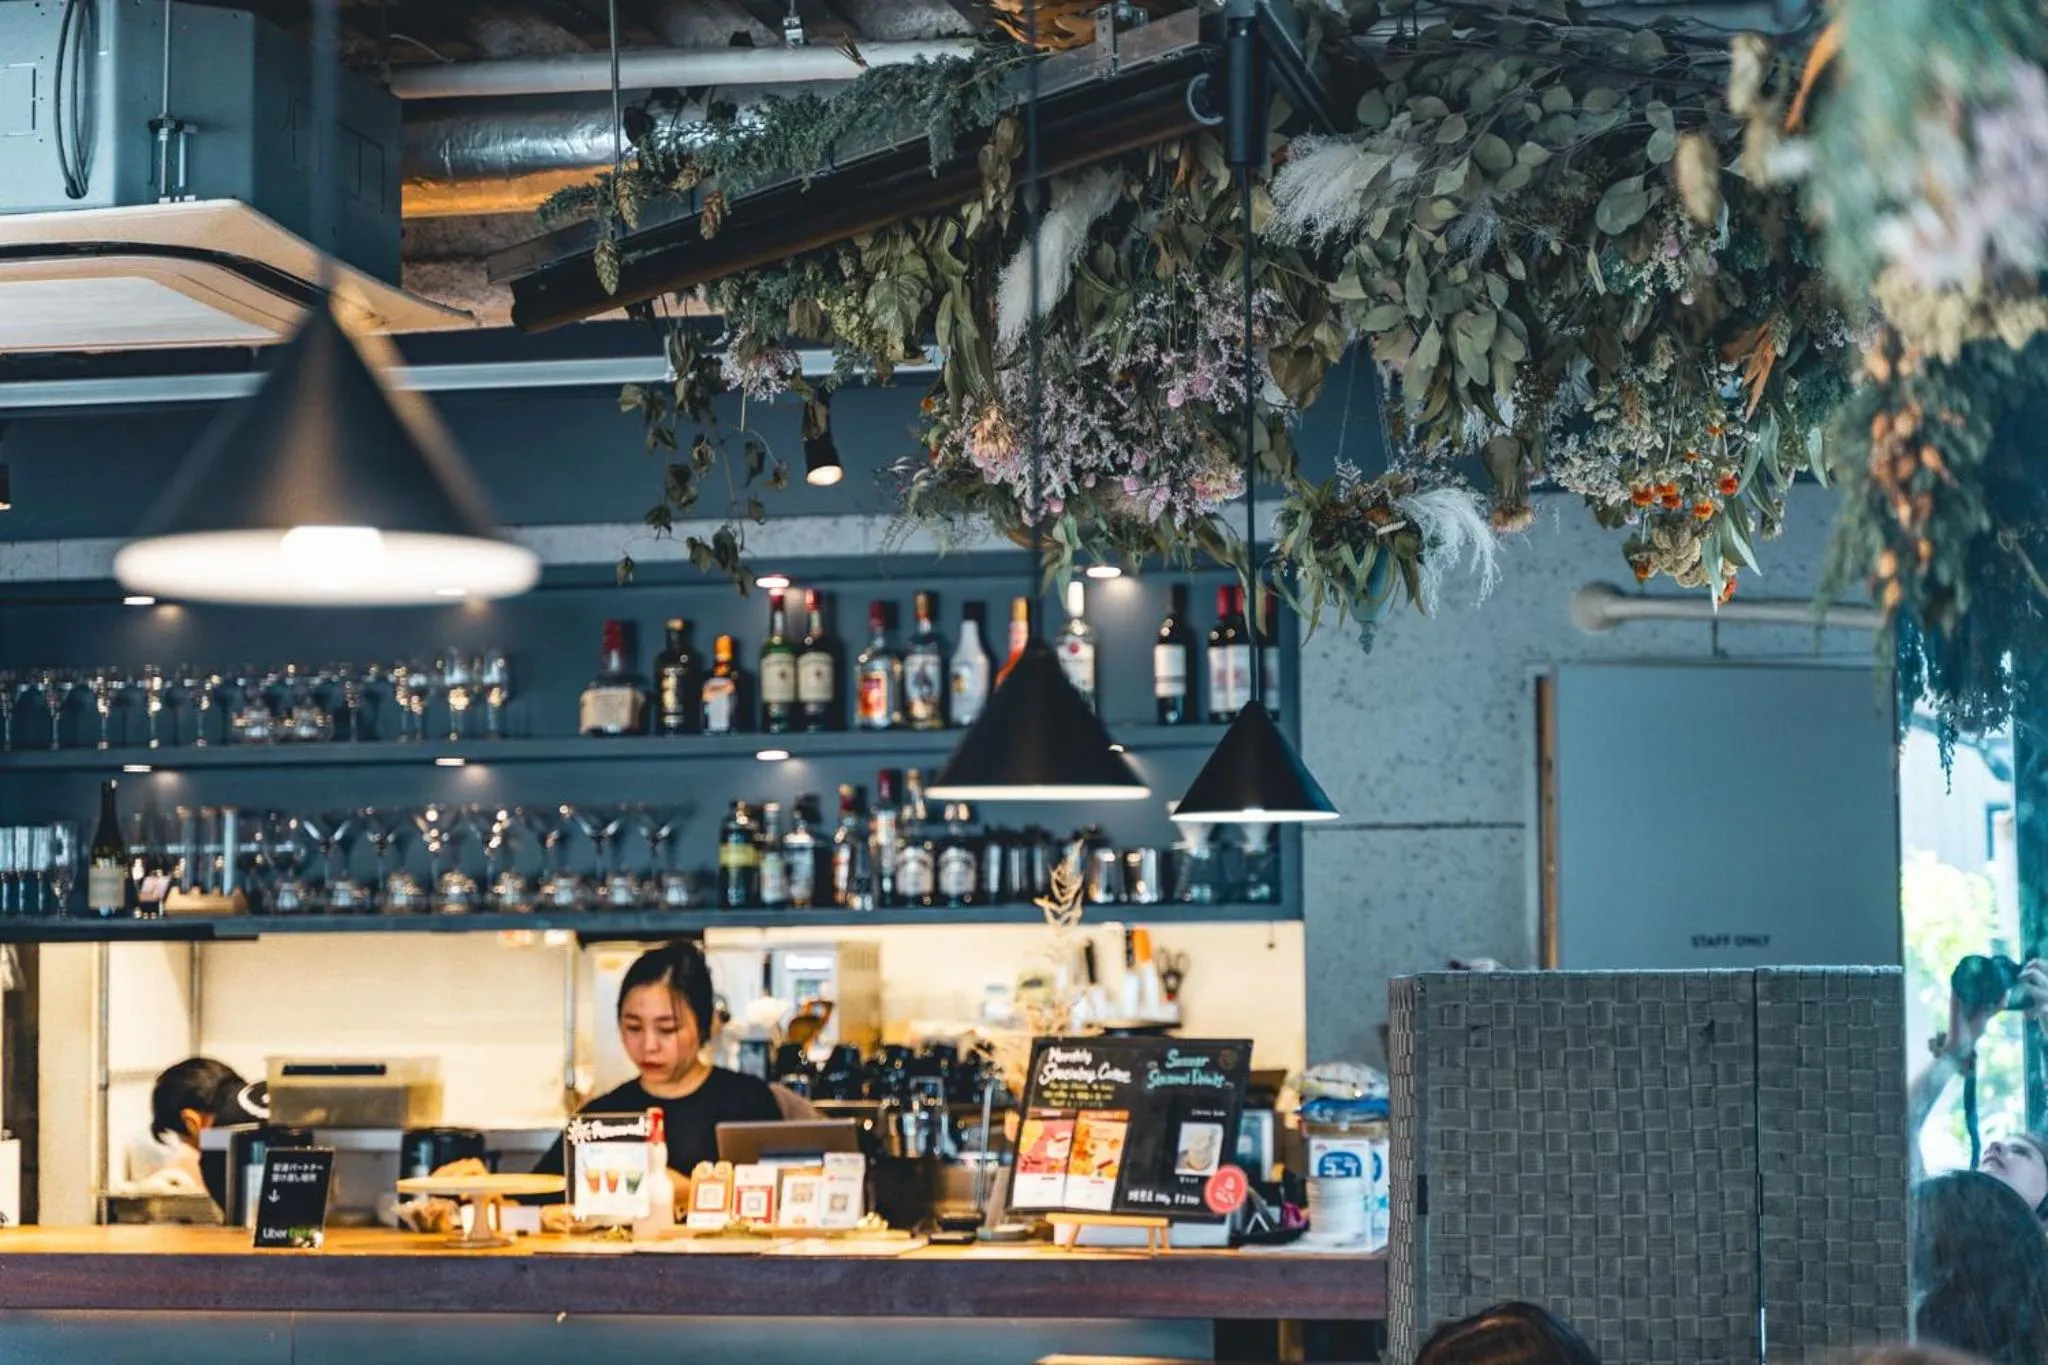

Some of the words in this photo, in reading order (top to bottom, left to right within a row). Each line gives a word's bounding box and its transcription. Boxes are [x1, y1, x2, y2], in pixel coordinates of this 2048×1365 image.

[1692, 934, 1730, 949] STAFF
[1734, 934, 1770, 949] ONLY
[263, 1227, 288, 1239] Uber
